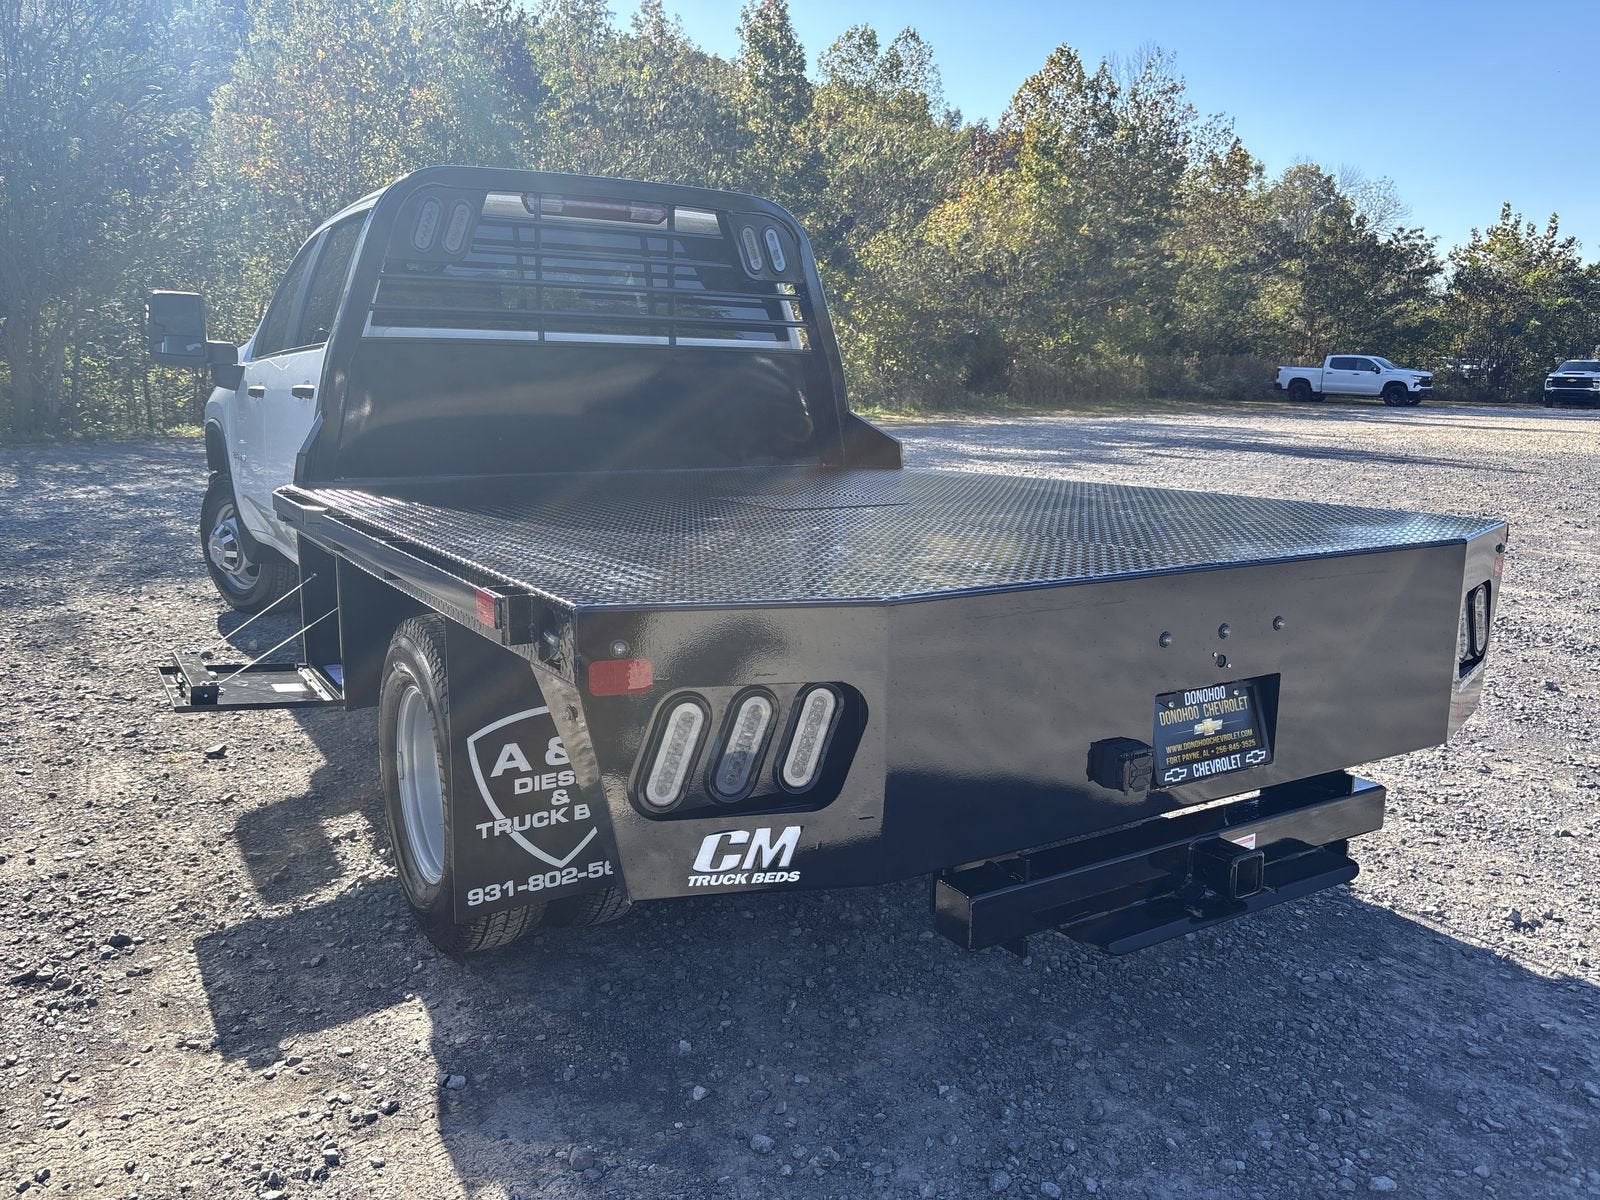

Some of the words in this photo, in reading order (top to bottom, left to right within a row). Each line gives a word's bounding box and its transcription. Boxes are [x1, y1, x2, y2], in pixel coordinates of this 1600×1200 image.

[1184, 685, 1226, 706] DONOHOO
[1159, 705, 1200, 726] DONOHOO
[1203, 696, 1249, 717] CHEVROLET
[1165, 728, 1253, 754] WWW.DONOHOOCHEVROLET.COM
[1166, 755, 1181, 765] FORT
[1202, 749, 1210, 757] AL
[1215, 739, 1257, 755] 256-845-3525
[490, 742, 533, 777] A
[1192, 754, 1241, 778] CHEVROLET
[514, 770, 576, 795] DIES
[551, 789, 570, 806] &
[475, 806, 569, 840] TRUCK
[692, 825, 802, 873] CM
[687, 873, 749, 887] TRUCK
[751, 871, 801, 884] BEDS
